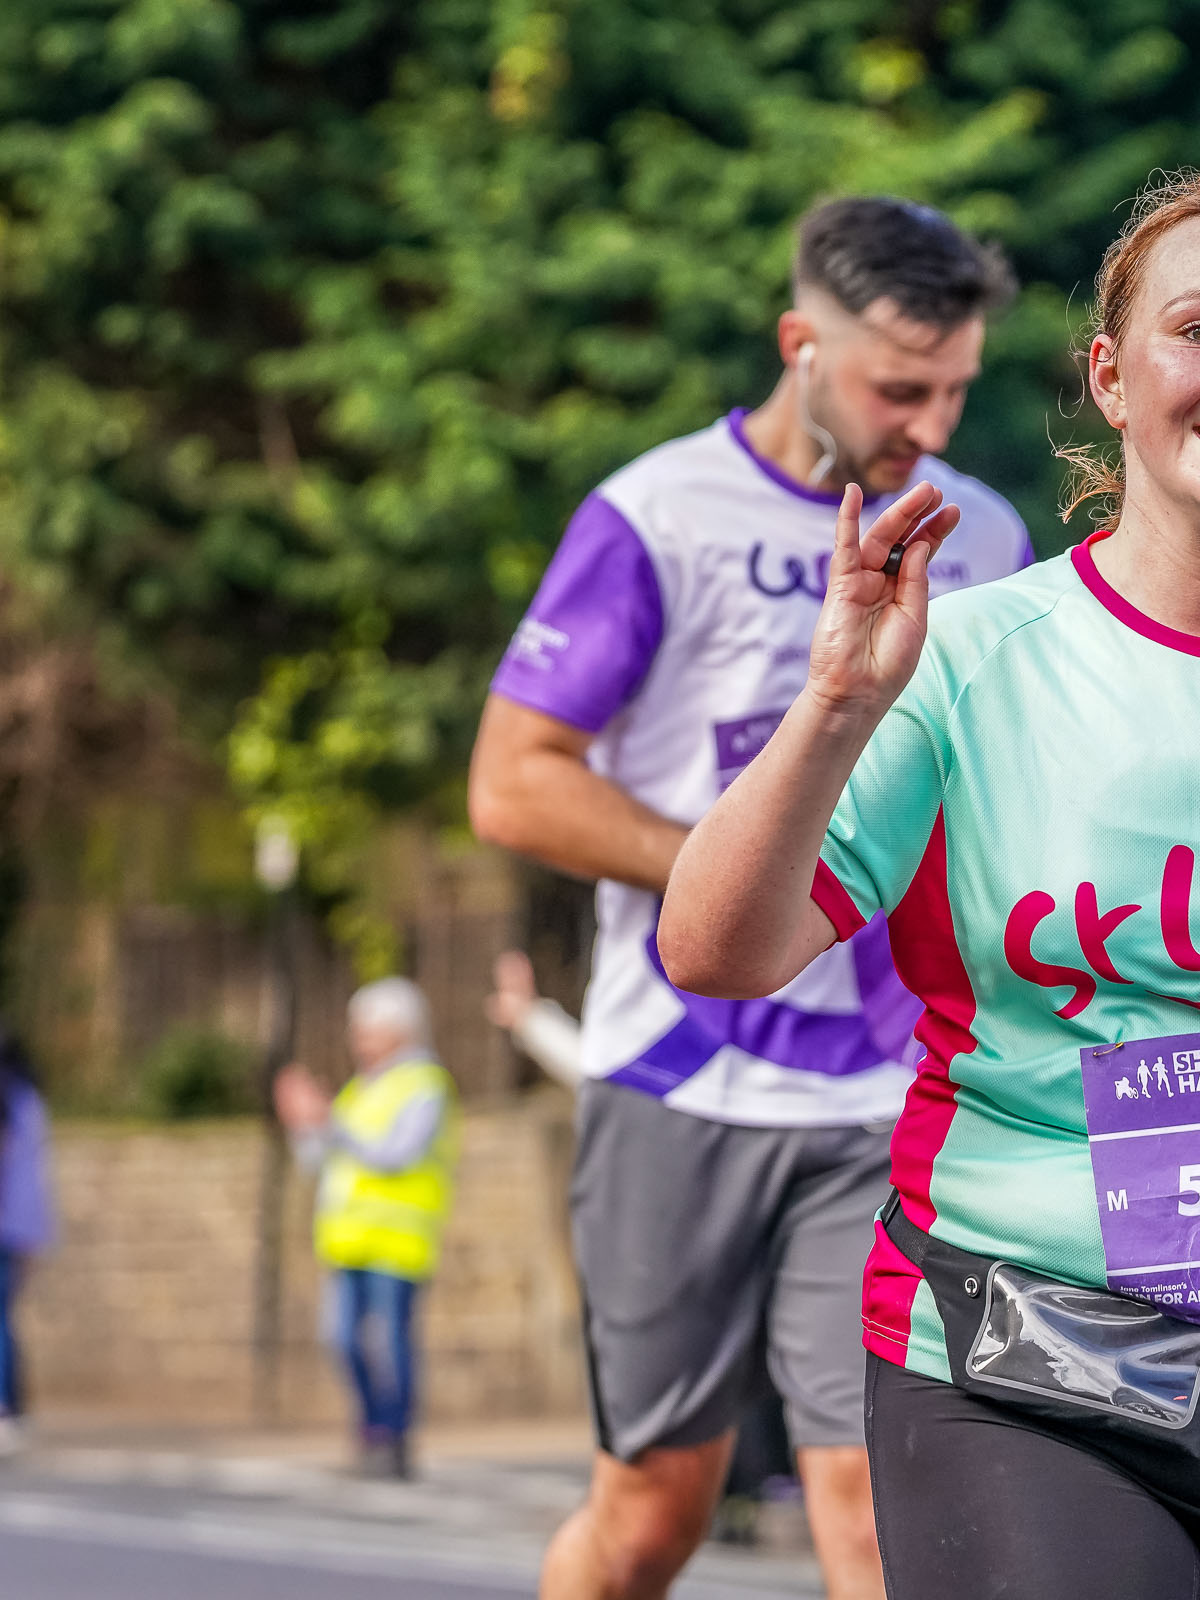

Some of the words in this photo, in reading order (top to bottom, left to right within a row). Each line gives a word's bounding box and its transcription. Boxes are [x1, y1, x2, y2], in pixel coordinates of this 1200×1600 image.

[1107, 1189, 1129, 1212] M
[1141, 1281, 1188, 1294] Tomlinson's
[1154, 1292, 1183, 1305] FOR
